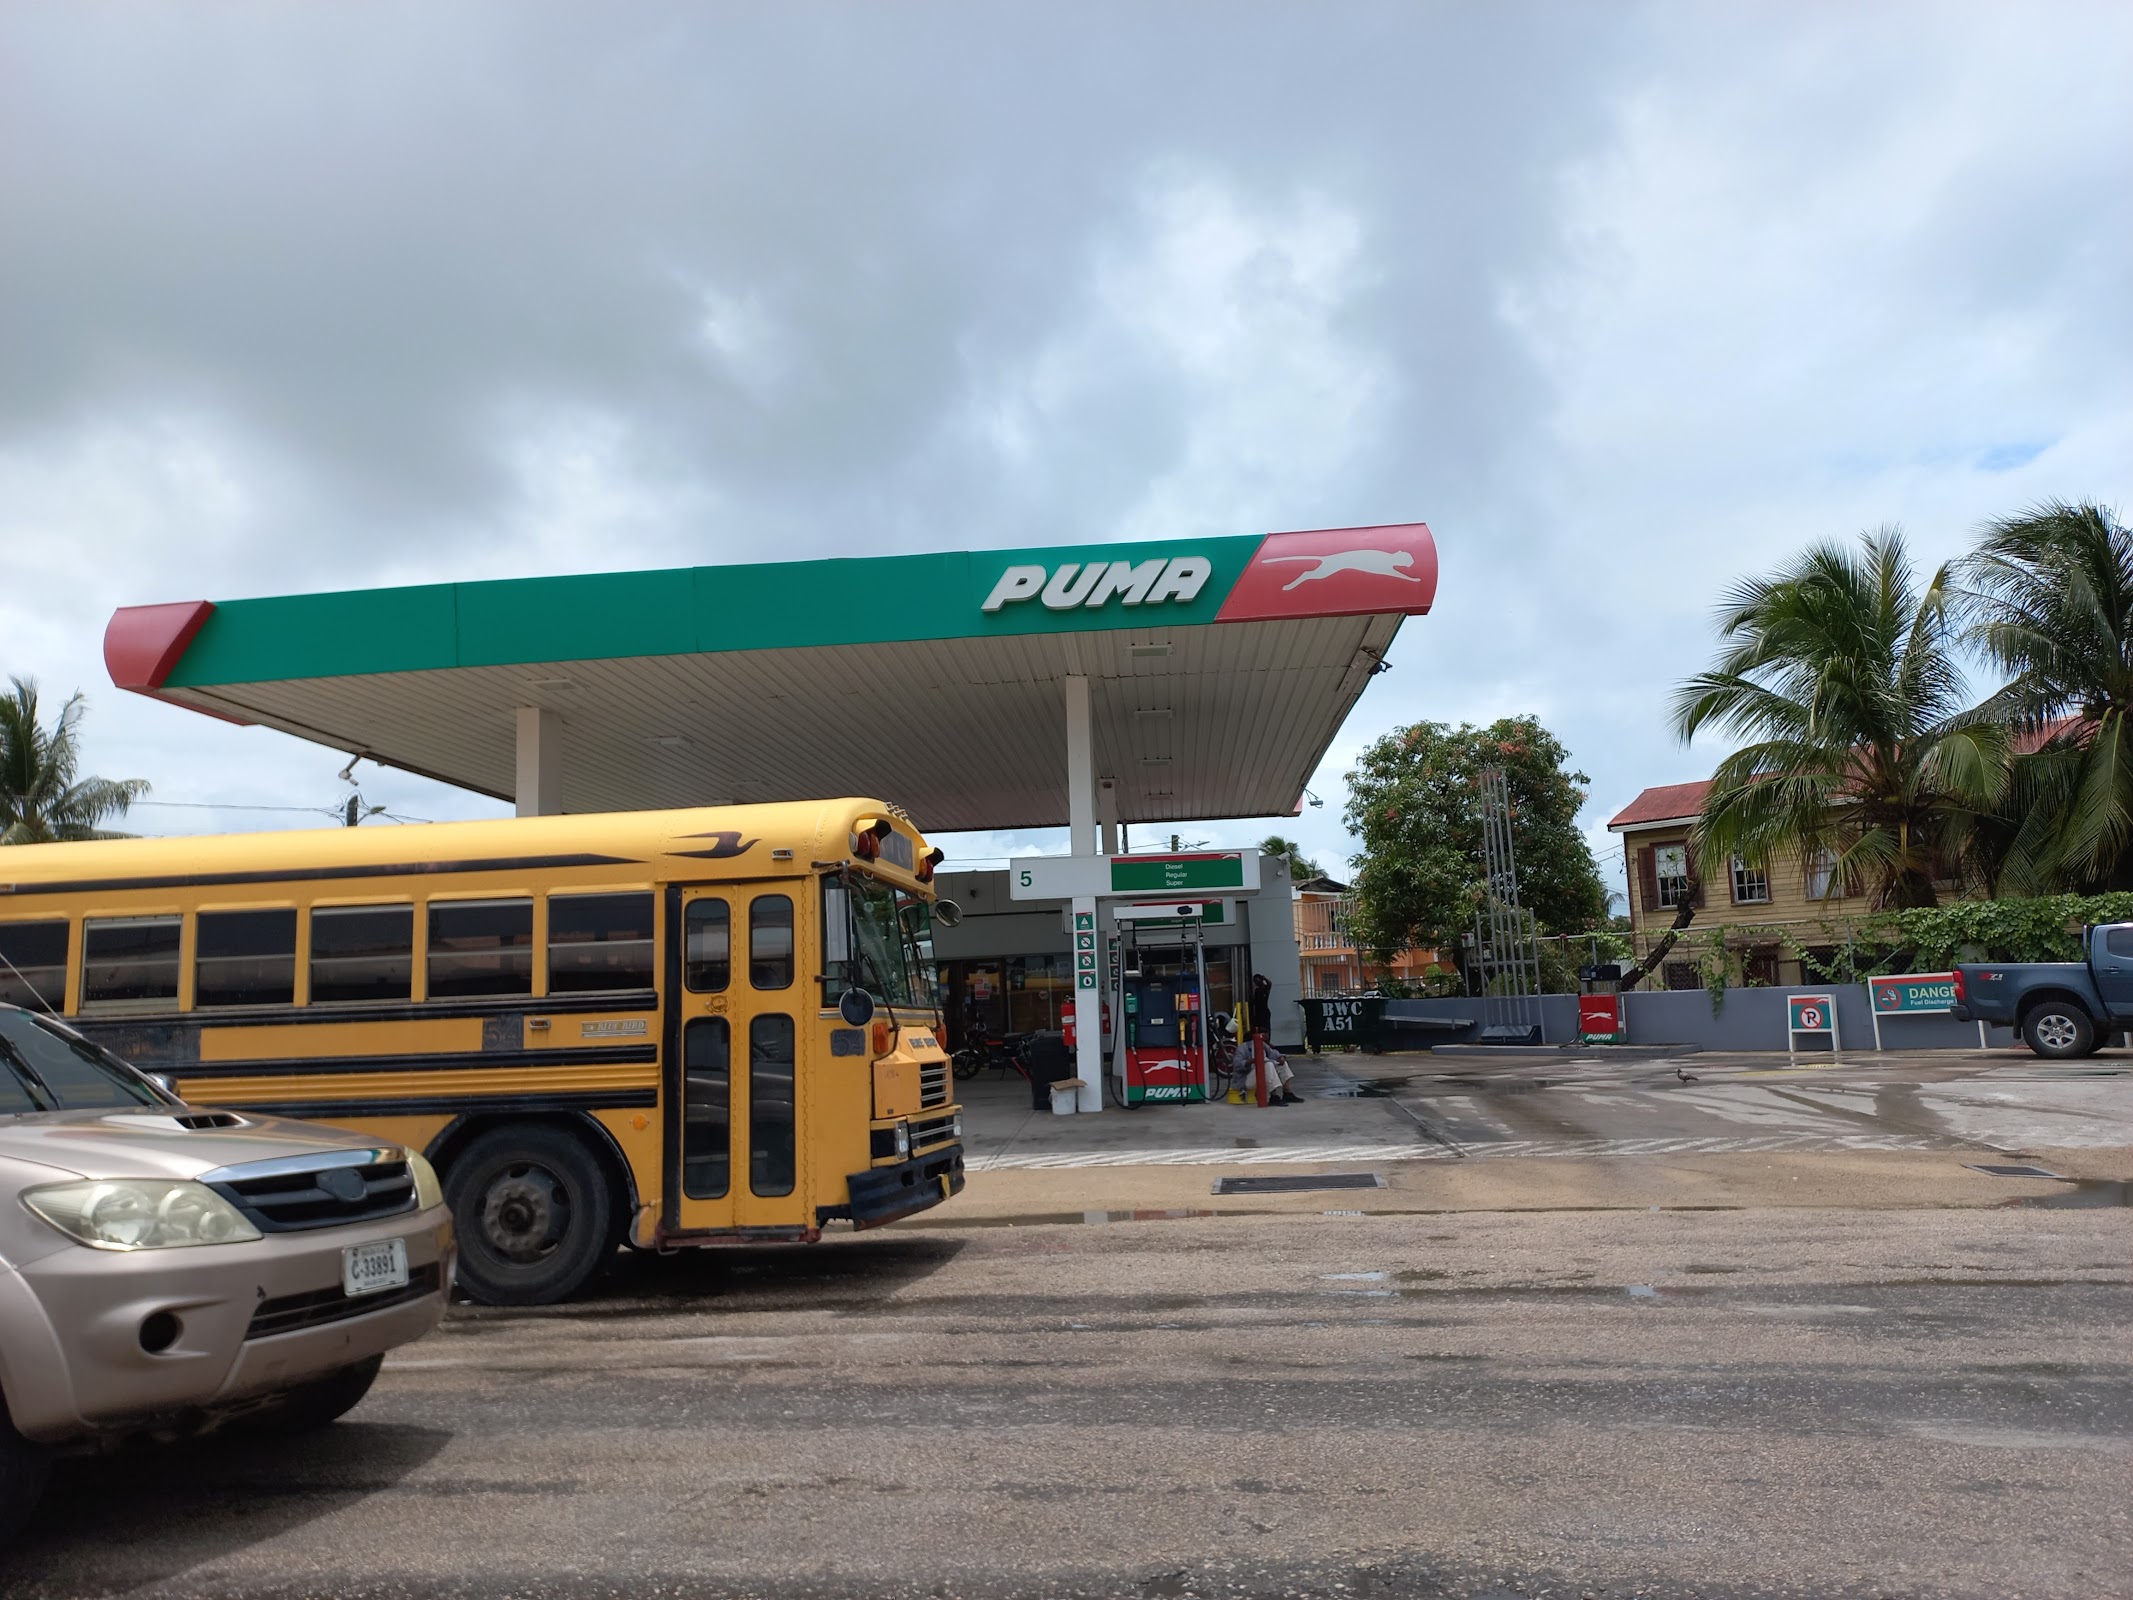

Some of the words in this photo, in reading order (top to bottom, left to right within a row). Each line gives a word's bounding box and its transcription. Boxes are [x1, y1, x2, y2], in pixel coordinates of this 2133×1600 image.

[980, 556, 1212, 612] PUMA
[1020, 870, 1033, 887] 5
[1908, 986, 1956, 999] DANGE
[1321, 1001, 1363, 1017] BWC
[1323, 1016, 1353, 1031] A51
[1585, 1033, 1613, 1041] PUMA
[1145, 1086, 1192, 1099] PUMA
[351, 1254, 396, 1280] C-33891
